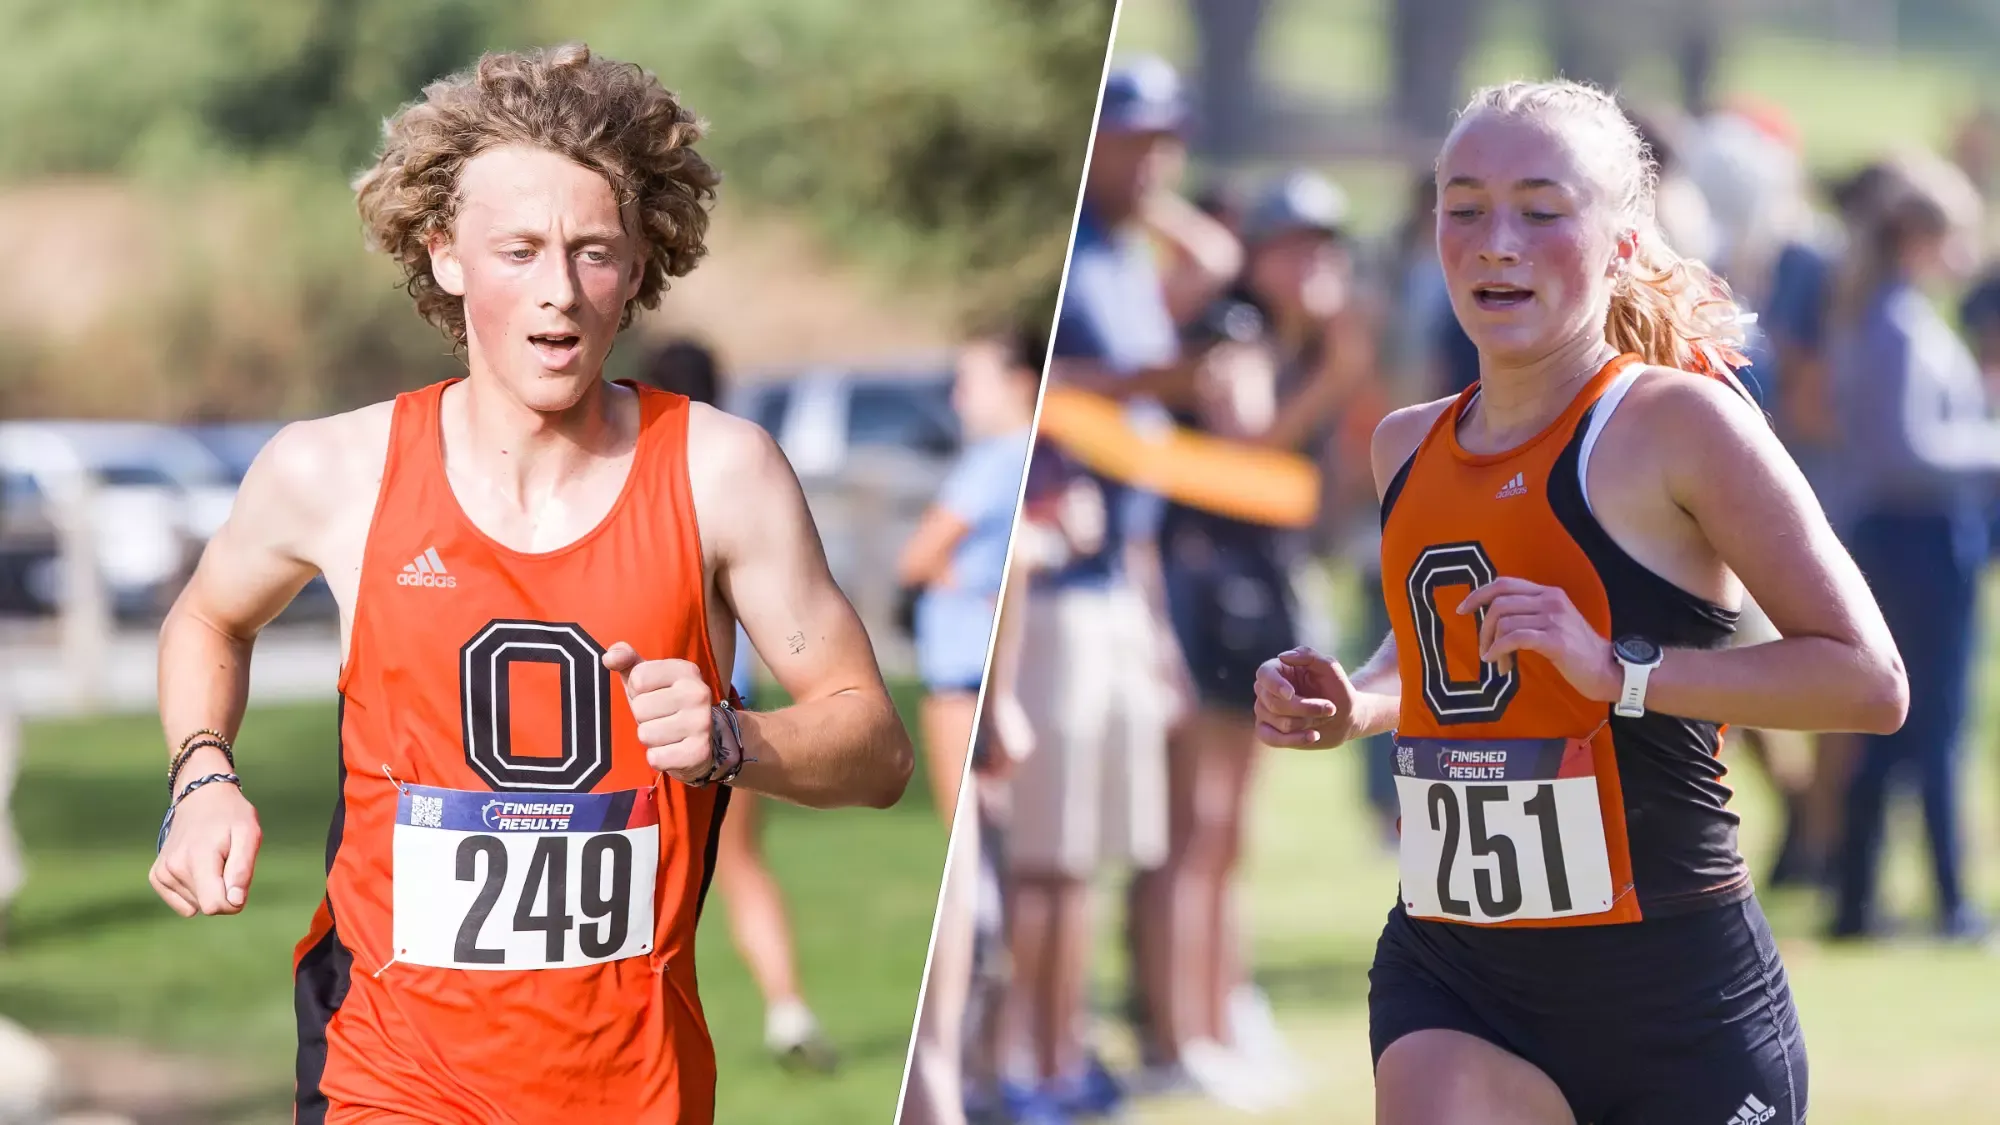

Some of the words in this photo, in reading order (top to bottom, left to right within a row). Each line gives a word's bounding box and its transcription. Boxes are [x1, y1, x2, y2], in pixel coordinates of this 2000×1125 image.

[1495, 486, 1528, 499] adidas
[396, 571, 457, 588] adidas
[459, 618, 612, 793] O
[1450, 750, 1507, 763] FINISHED
[1448, 766, 1505, 779] RESULTS
[502, 803, 574, 815] FINISHED
[498, 818, 570, 830] RESULTS
[1427, 783, 1573, 918] 251
[454, 833, 632, 964] 249
[1740, 1105, 1776, 1125] idas
